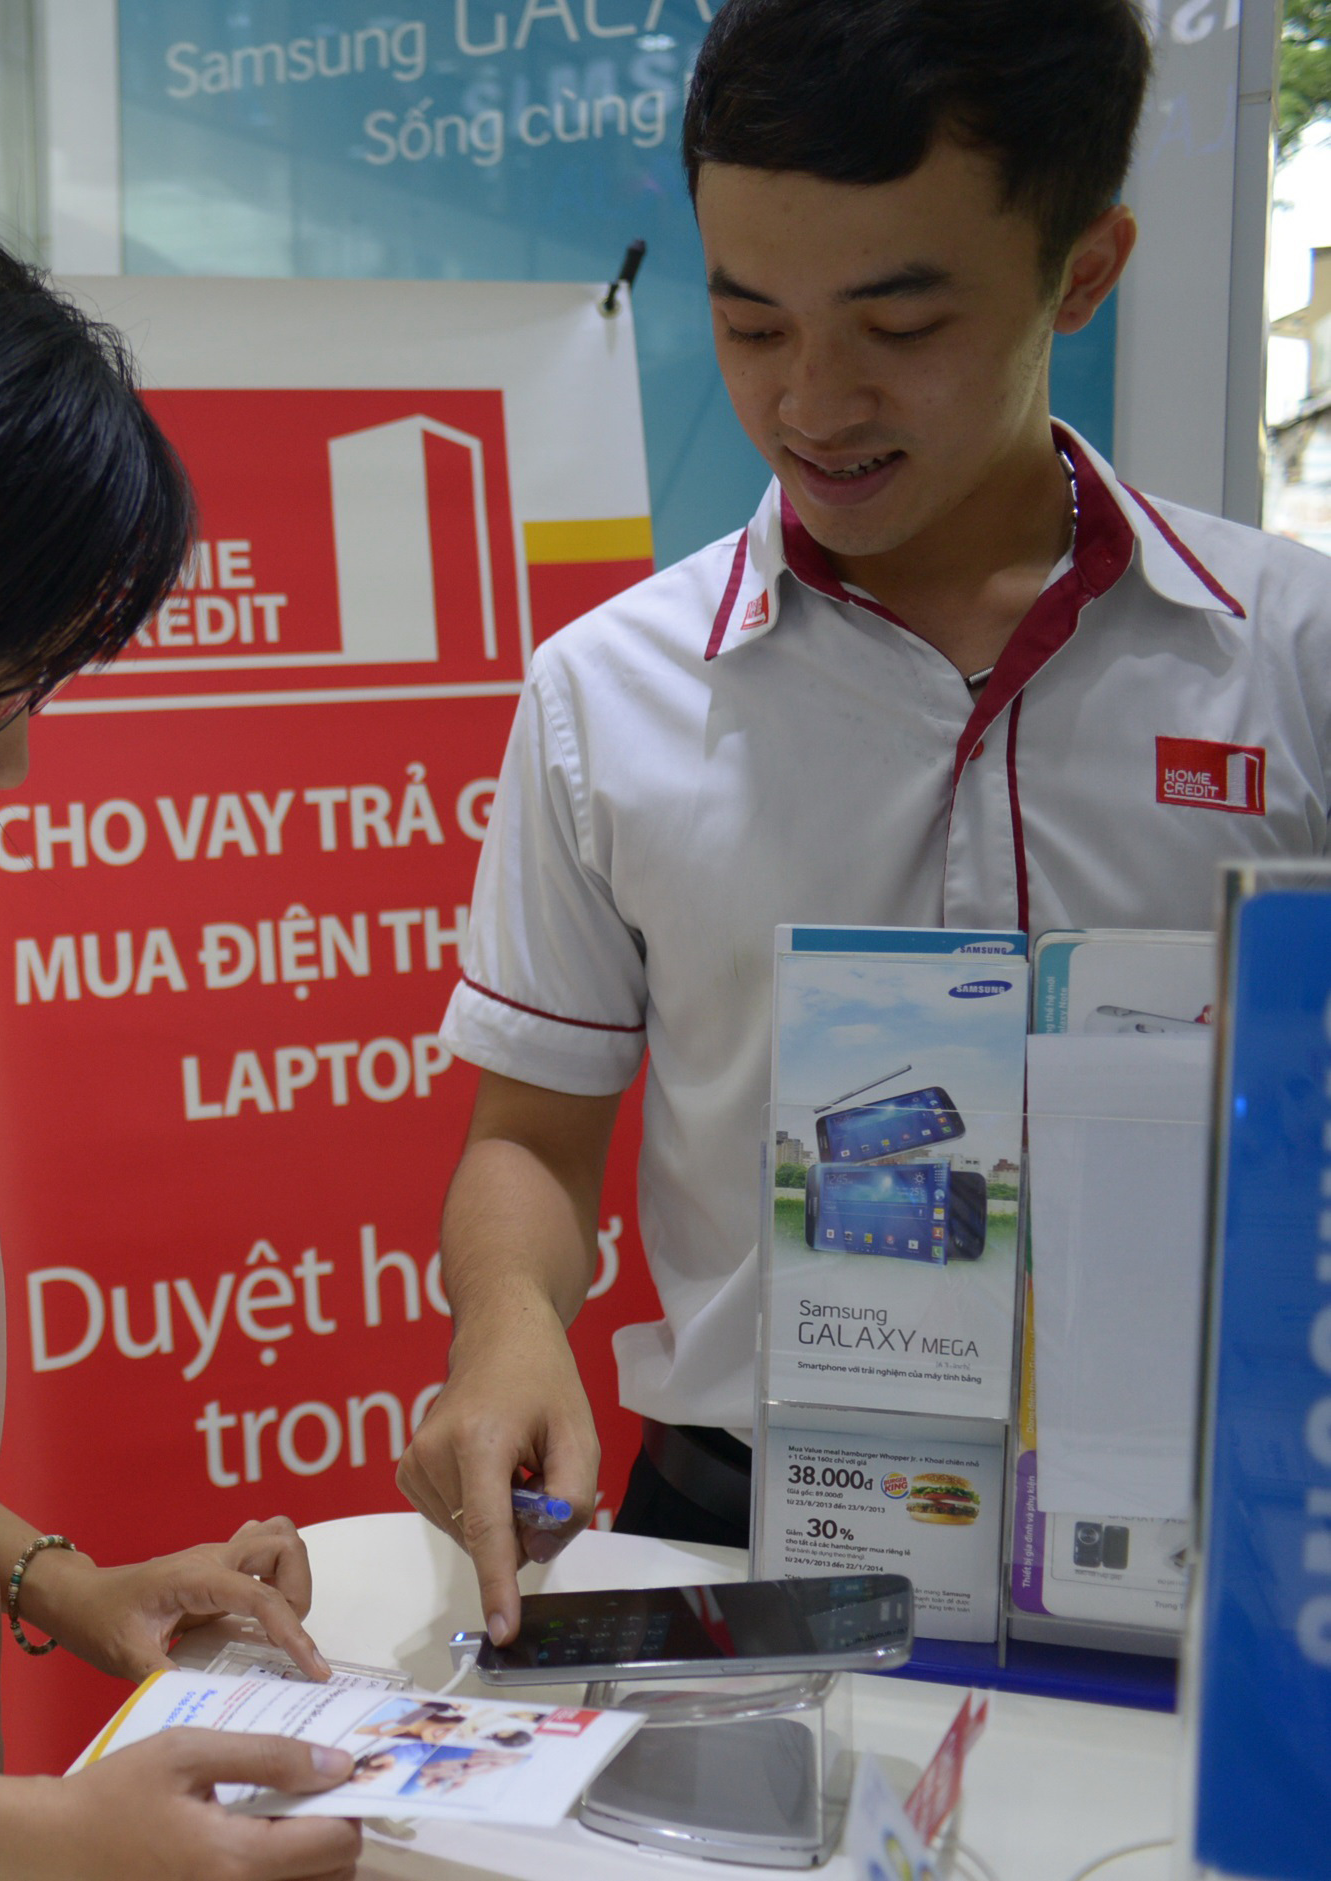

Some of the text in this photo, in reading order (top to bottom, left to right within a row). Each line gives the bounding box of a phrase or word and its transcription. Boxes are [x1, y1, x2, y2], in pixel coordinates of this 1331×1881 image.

[164, 20, 426, 100] Samsung
[363, 98, 504, 165] Sống
[520, 86, 666, 148] cùng
[1165, 768, 1211, 785] HOME
[1164, 781, 1219, 798] CREDIT
[157, 791, 294, 862] VAY
[303, 762, 444, 851] TRẢ
[15, 928, 187, 1005] MUA
[198, 903, 370, 1000] ĐIỆN
[960, 946, 1007, 955] SAMSUNG
[956, 985, 1006, 994] SAMSUNG
[182, 1032, 454, 1121] LAPTOP
[26, 1238, 336, 1381] Duyệt
[799, 1299, 887, 1326] Samsung
[798, 1321, 979, 1358] GALAXY MEGA
[797, 1361, 847, 1372] Smartphone
[803, 1446, 822, 1454] Value
[841, 1450, 878, 1459] hamburger
[879, 1453, 909, 1462] Whopper
[883, 1477, 907, 1485] BURGER
[884, 1482, 908, 1493] KING
[831, 1543, 868, 1552] hamburger
